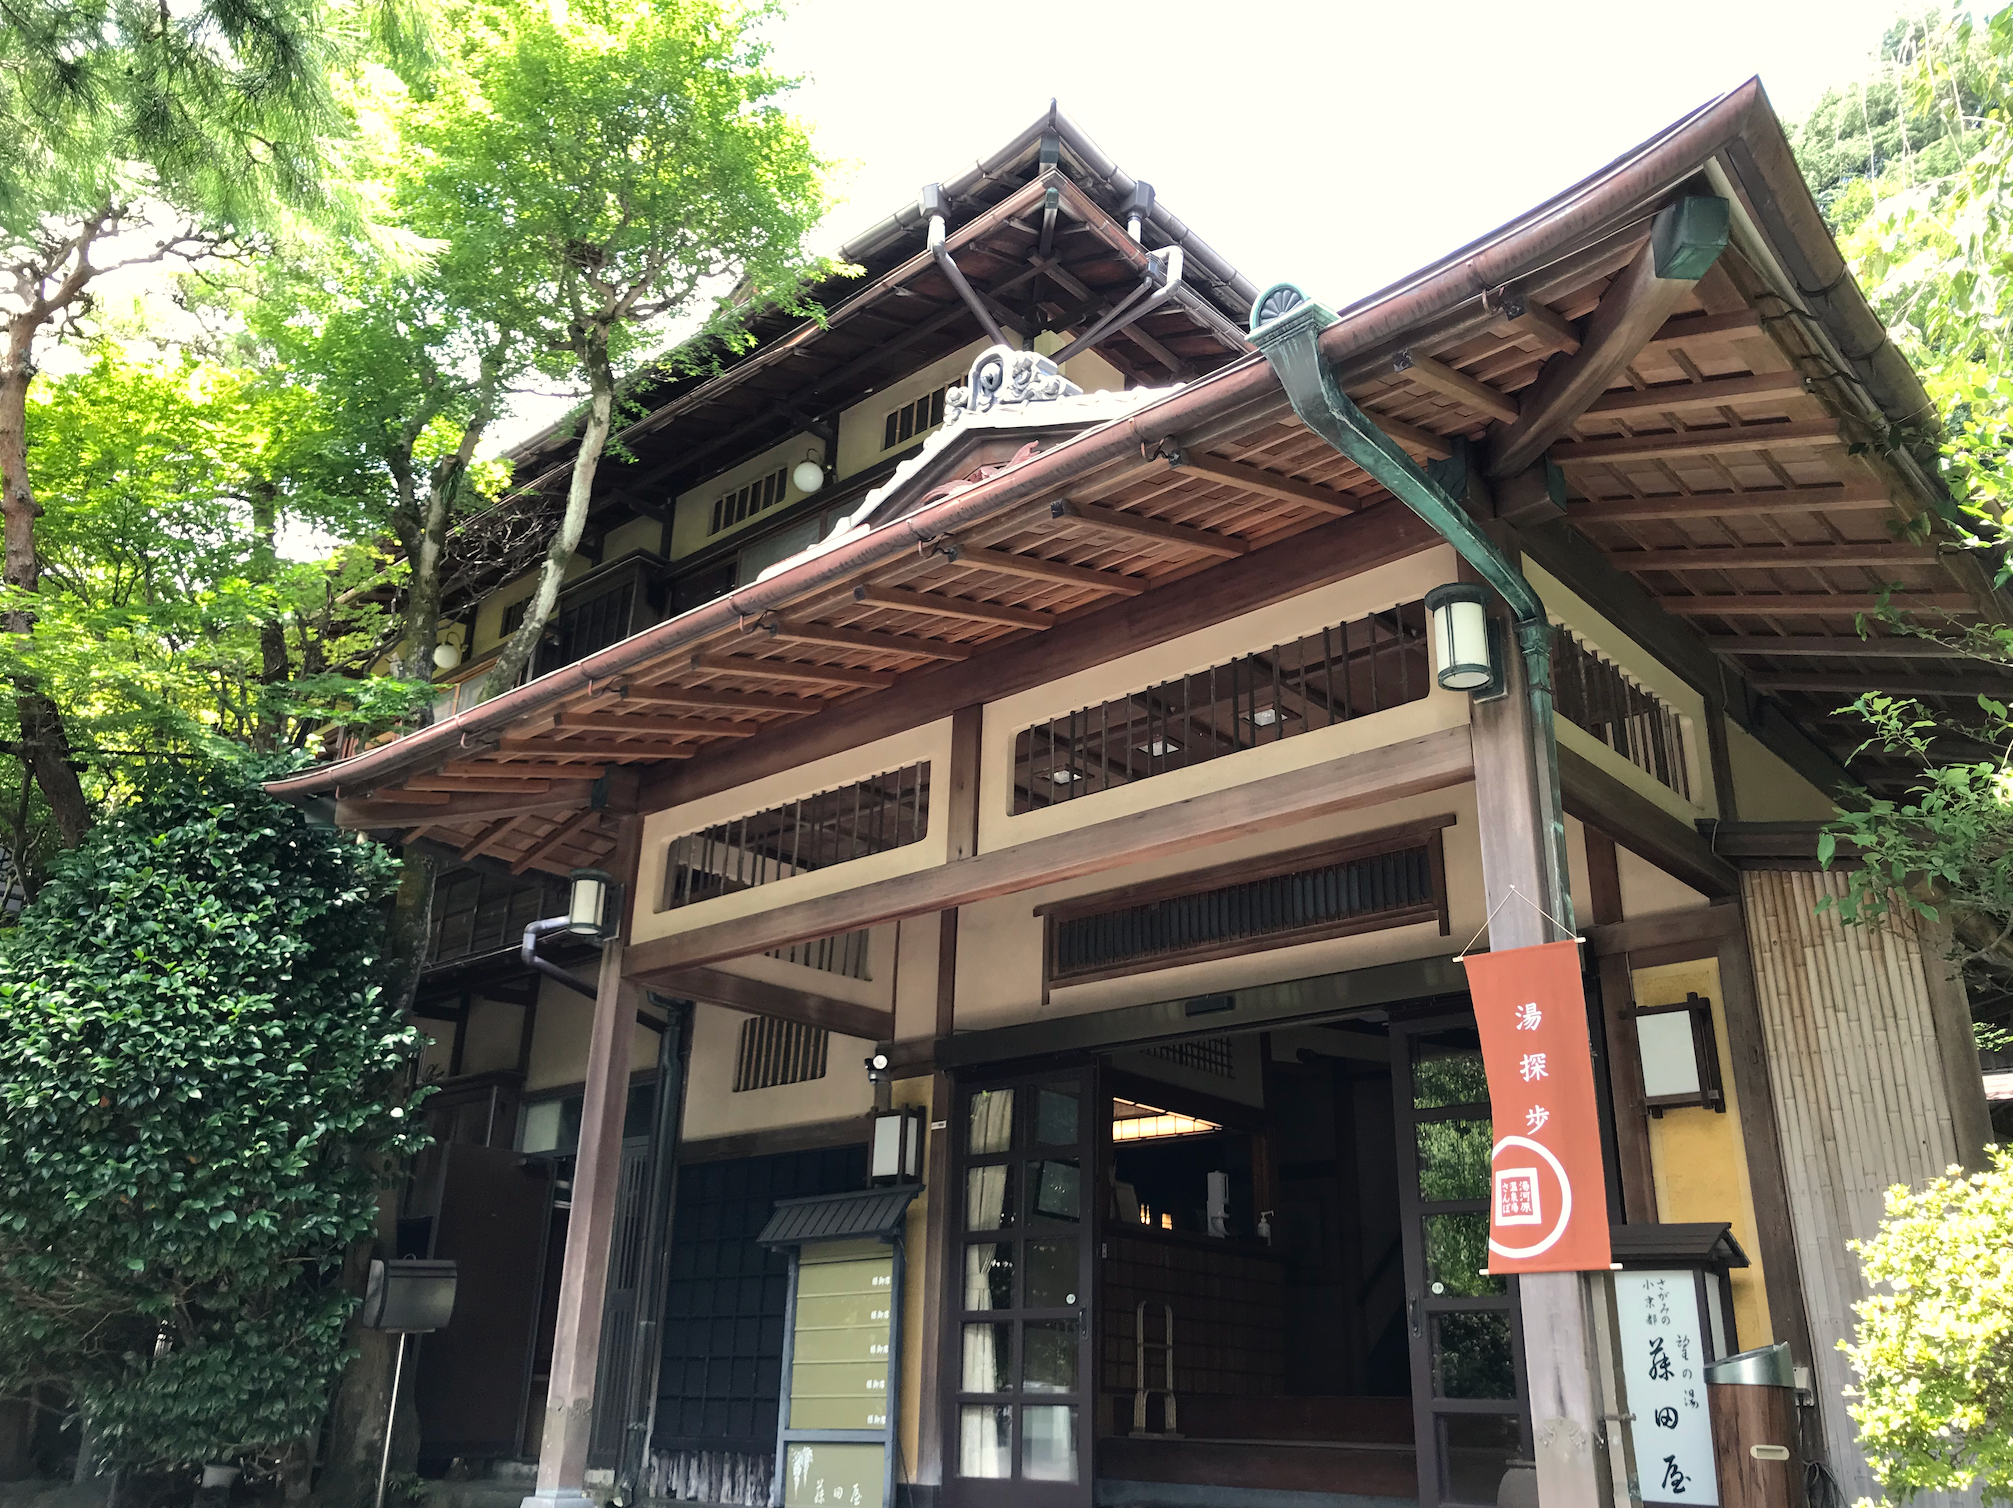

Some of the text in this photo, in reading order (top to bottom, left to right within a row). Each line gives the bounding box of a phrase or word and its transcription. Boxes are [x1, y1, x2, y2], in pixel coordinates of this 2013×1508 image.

[1514, 1001, 1550, 1135] 湯探歩
[1501, 1182, 1511, 1214] さんぽ
[1509, 1181, 1519, 1213] 温泉場
[1518, 1180, 1532, 1213] 湯河原
[1642, 1279, 1658, 1326] 小京都
[1656, 1278, 1671, 1326] さがみの
[1675, 1334, 1700, 1410] 望の湯
[1648, 1336, 1692, 1495] 藤田屋
